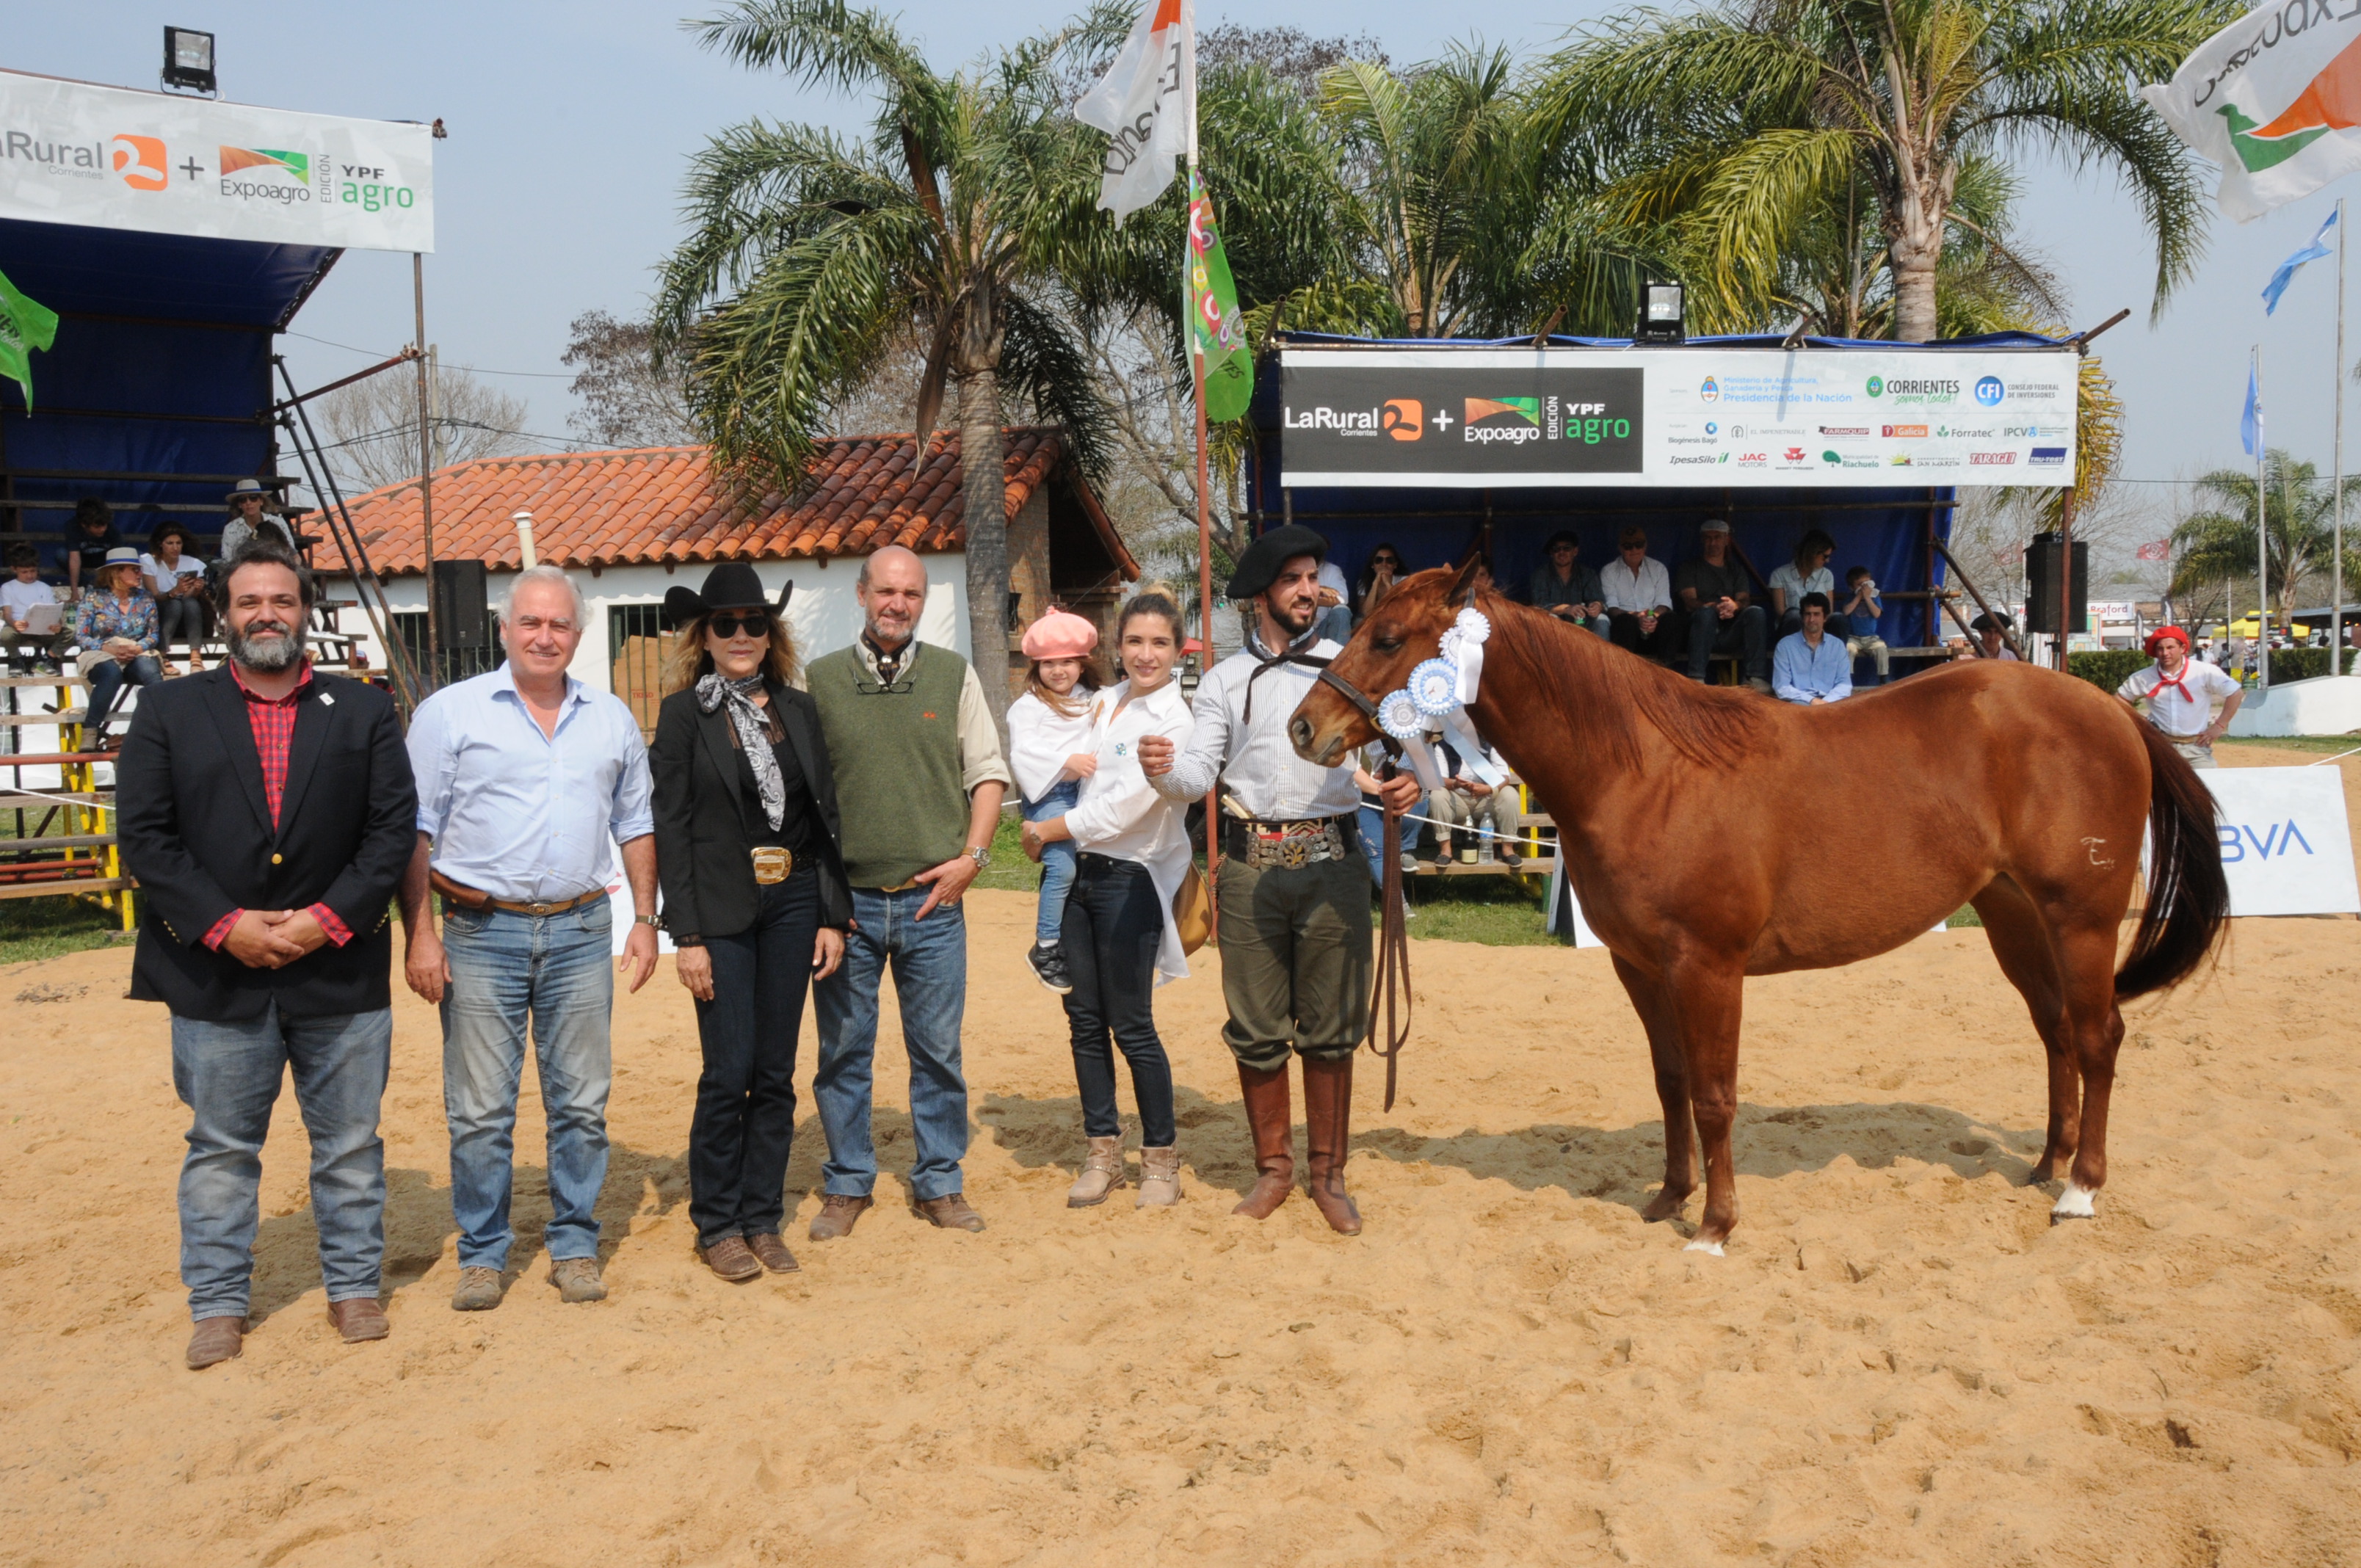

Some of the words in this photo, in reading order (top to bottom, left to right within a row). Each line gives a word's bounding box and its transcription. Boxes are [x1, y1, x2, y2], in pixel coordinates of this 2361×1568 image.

[0, 131, 103, 169] Rural
[48, 165, 104, 180] Corrientes
[319, 153, 333, 203] EDICIÓN
[341, 164, 385, 179] YPF
[220, 179, 310, 205] Expoagro
[341, 182, 413, 212] agro
[1887, 380, 1959, 393] CORRIENTES
[1977, 383, 2001, 399] CFI
[1723, 393, 1785, 402] Presidencia
[1788, 393, 1801, 402] de
[1804, 393, 1813, 402] la
[1816, 393, 1852, 402] Nación
[1565, 403, 1606, 415] YPF
[1285, 406, 1378, 429] LaRural
[1547, 396, 1559, 440] EDICIÓN
[1340, 429, 1378, 437] Corrientes
[1465, 426, 1540, 445] Expoagro
[1566, 418, 1631, 445] agro
[1898, 427, 1925, 436] Galicia
[1951, 429, 1992, 438] Forratec
[1669, 455, 1716, 465] IpesaSilo
[1738, 453, 1767, 461] JAC
[2090, 604, 2128, 616] Braford
[2215, 818, 2315, 863] BVA
